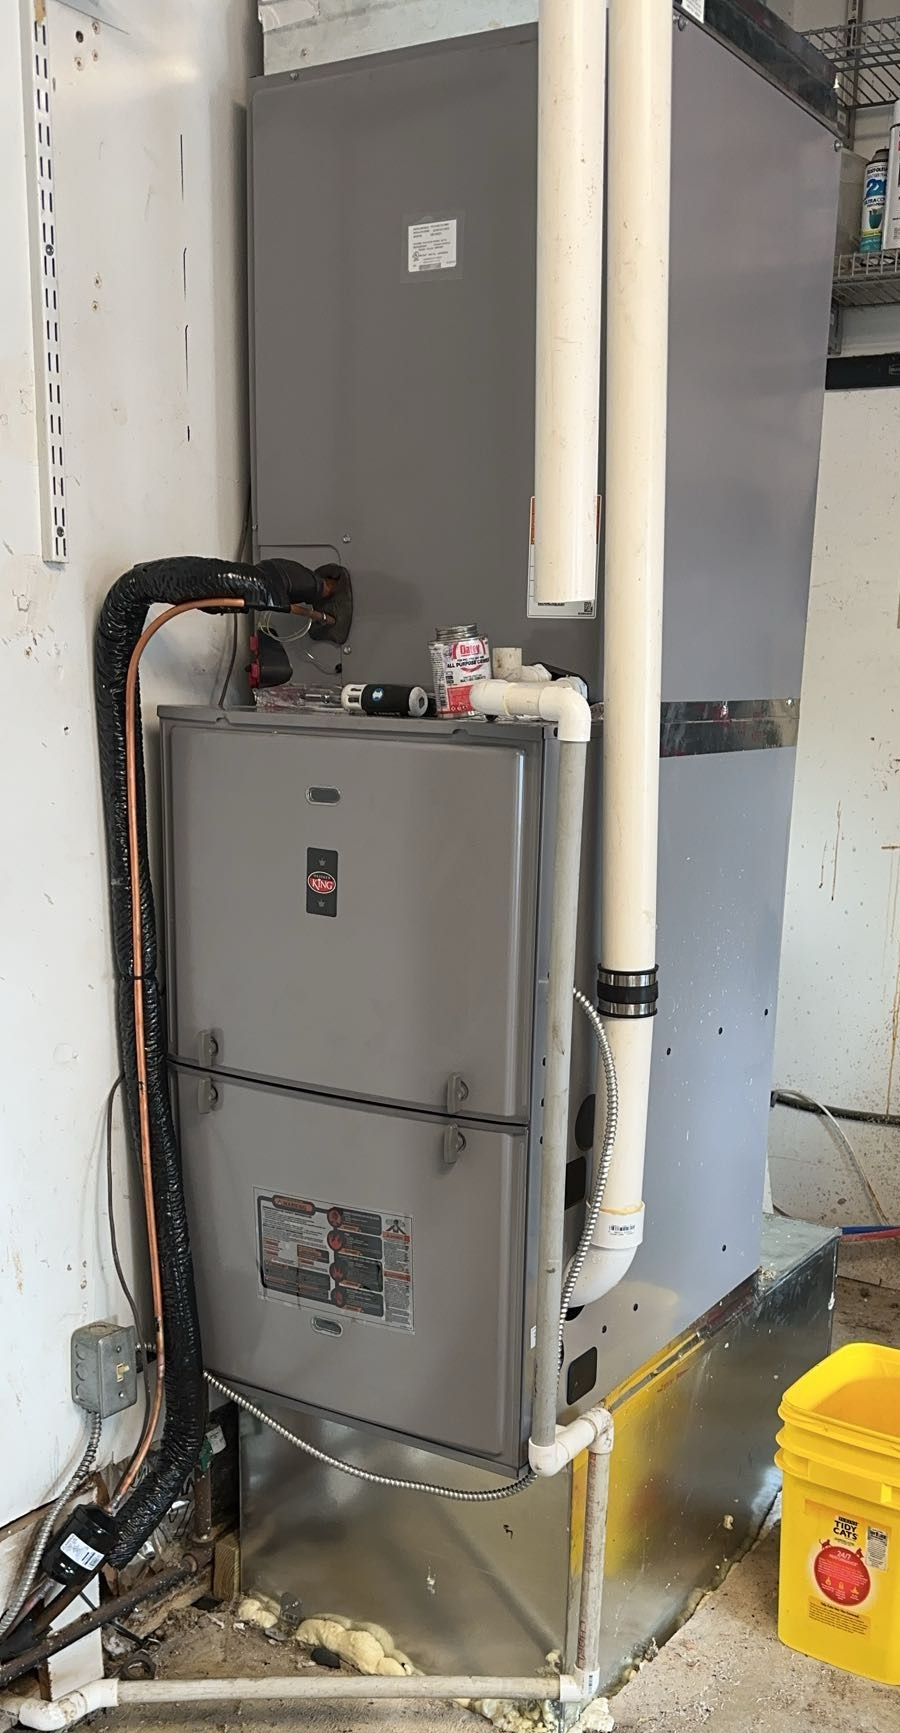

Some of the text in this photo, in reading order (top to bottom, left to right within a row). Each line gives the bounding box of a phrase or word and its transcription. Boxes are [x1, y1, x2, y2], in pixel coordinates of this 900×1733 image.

[313, 879, 333, 890] KING
[835, 1520, 858, 1533] TIDY
[833, 1528, 858, 1541] CATS
